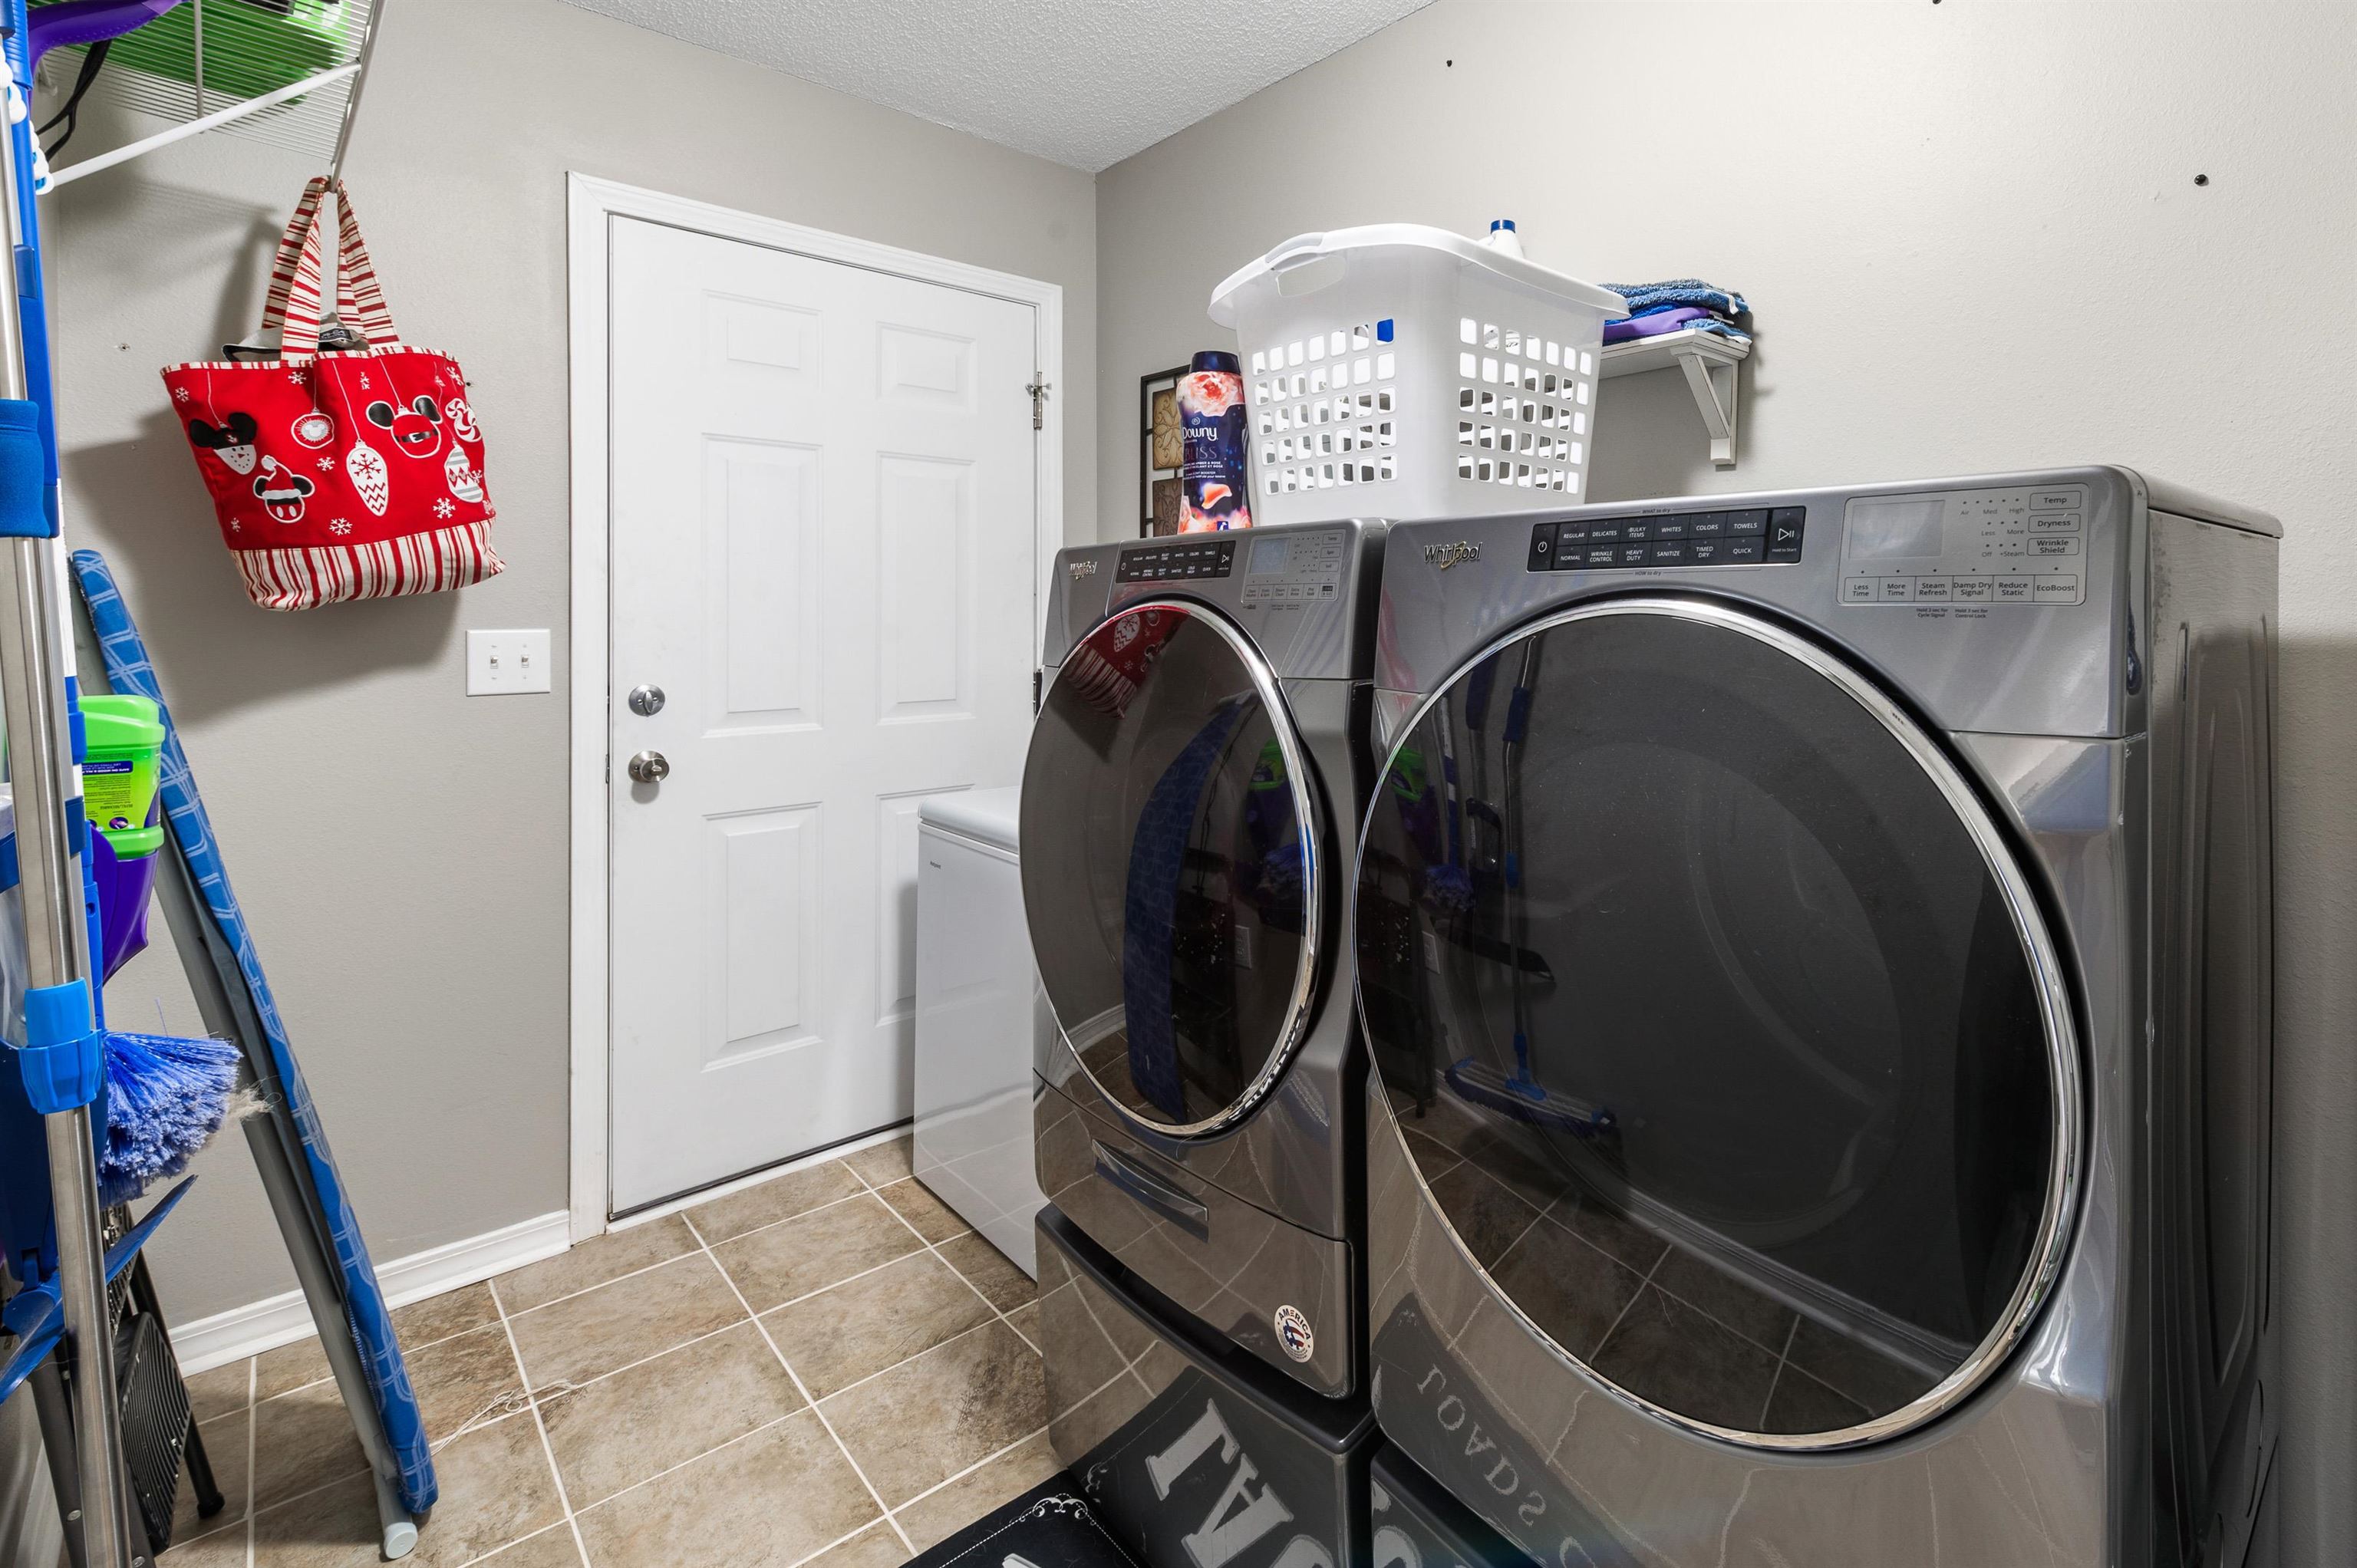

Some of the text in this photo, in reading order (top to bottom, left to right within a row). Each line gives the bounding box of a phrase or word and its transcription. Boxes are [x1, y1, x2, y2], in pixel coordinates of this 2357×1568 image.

[1182, 427, 1218, 442] Downy
[1185, 446, 1217, 460] BLISS
[1424, 540, 1483, 569] Whirlpool
[1978, 581, 1993, 590] Dry
[1278, 1307, 1311, 1340] AMERICA
